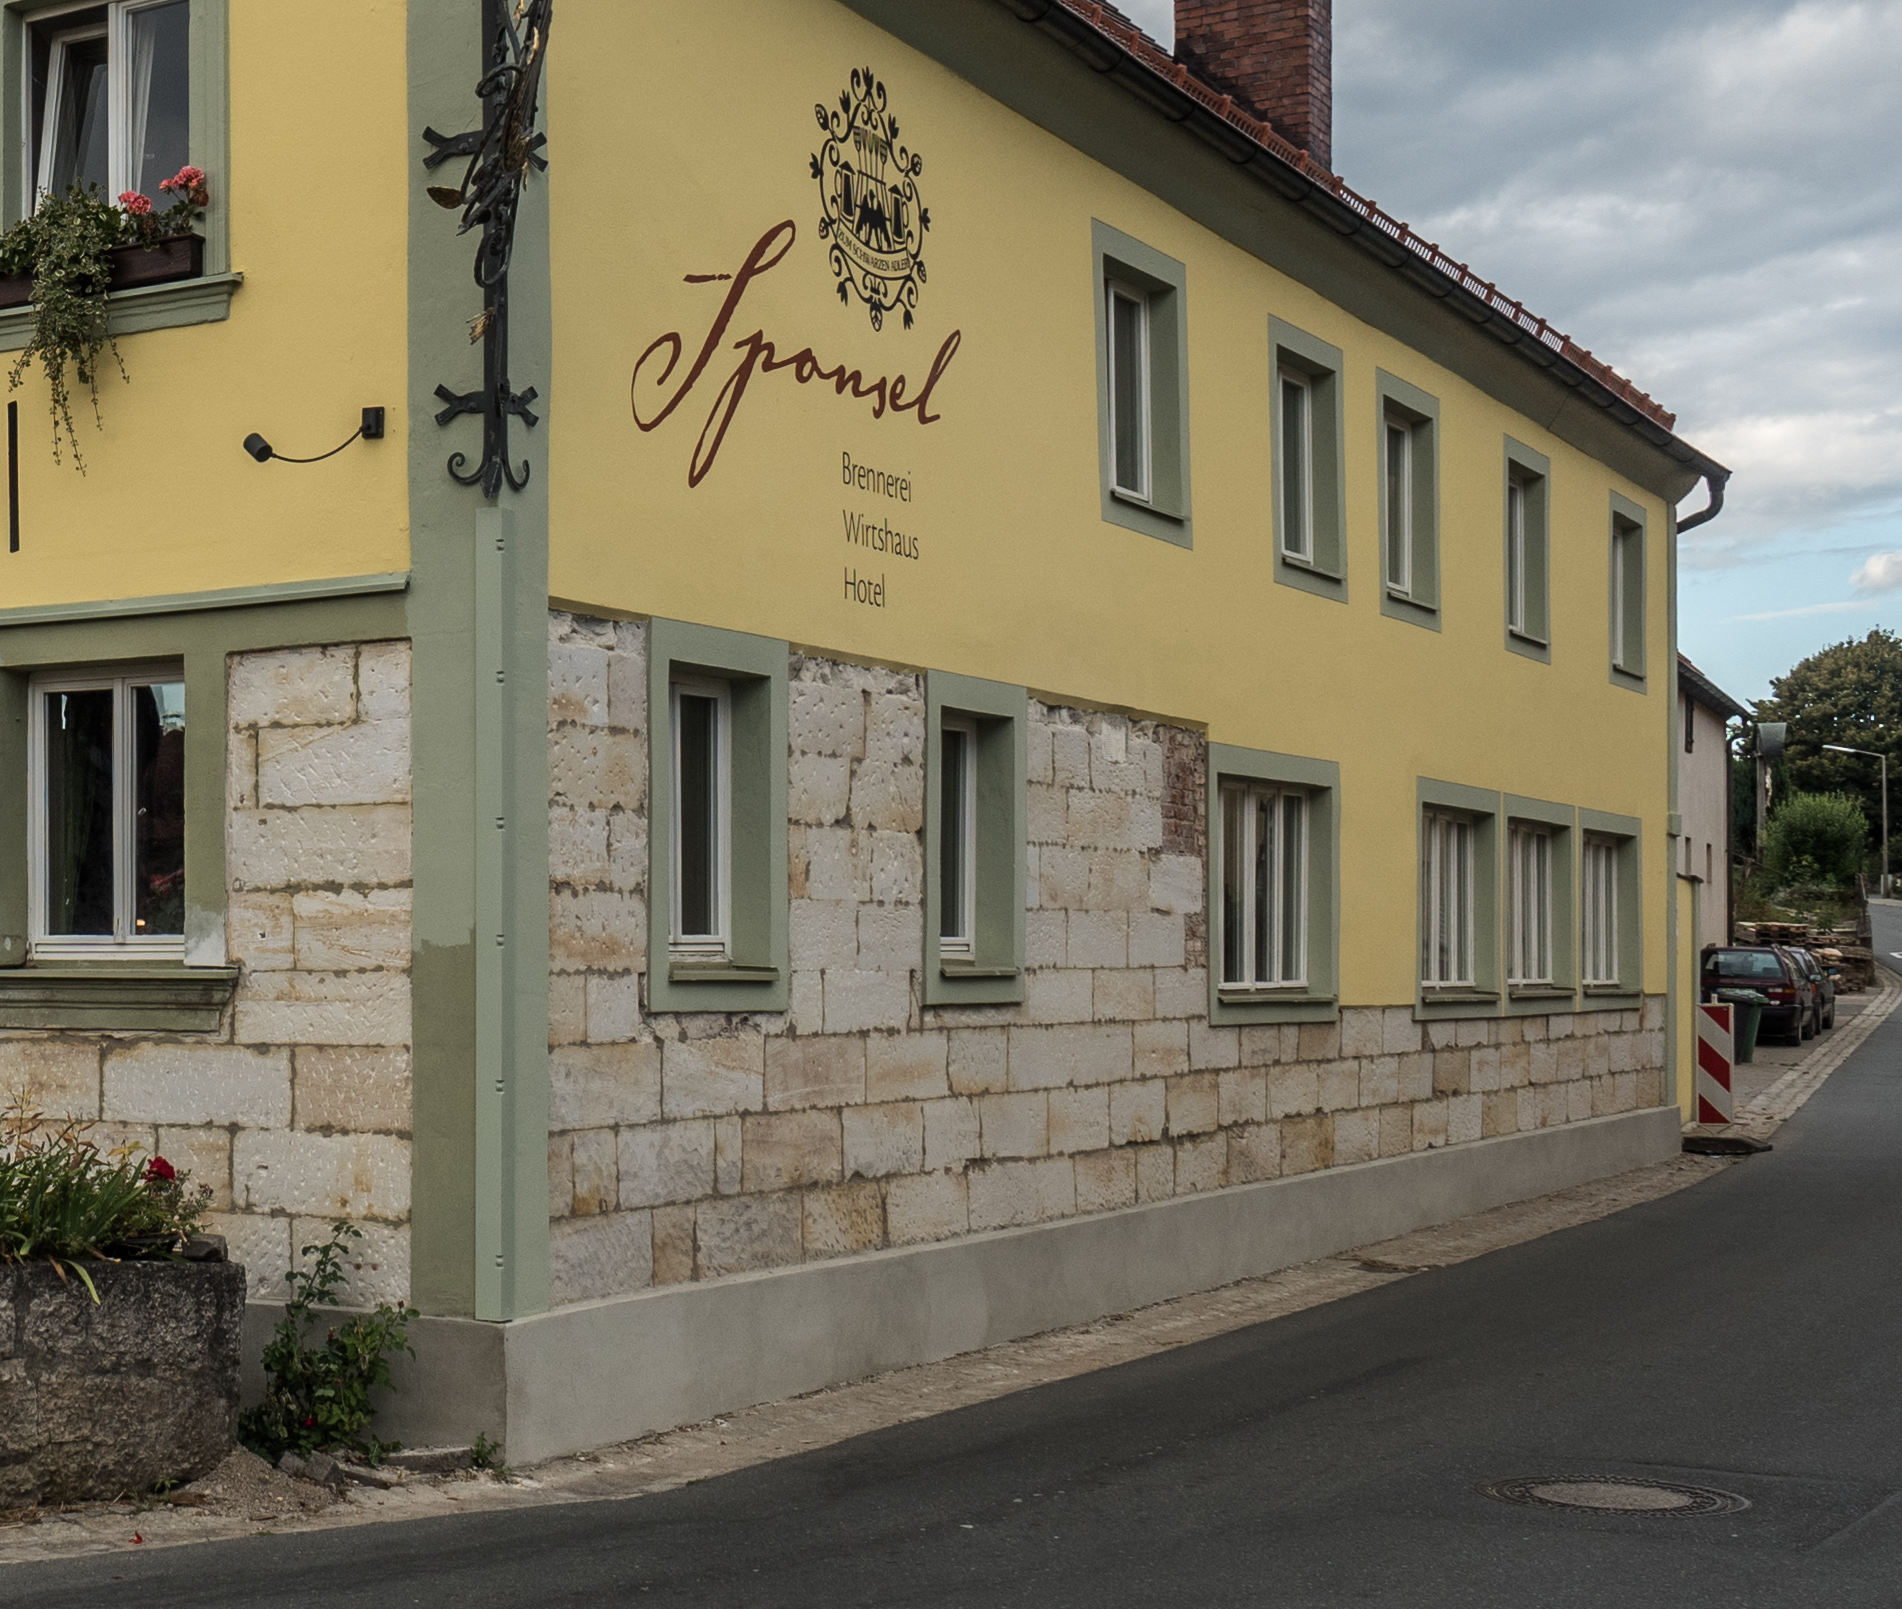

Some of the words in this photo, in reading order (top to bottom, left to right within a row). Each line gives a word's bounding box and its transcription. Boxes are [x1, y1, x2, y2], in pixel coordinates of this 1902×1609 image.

[631, 220, 961, 488] Sponsel
[842, 451, 912, 503] Brennerei
[842, 509, 919, 561] Wirtshaus
[844, 566, 886, 608] Hotel
